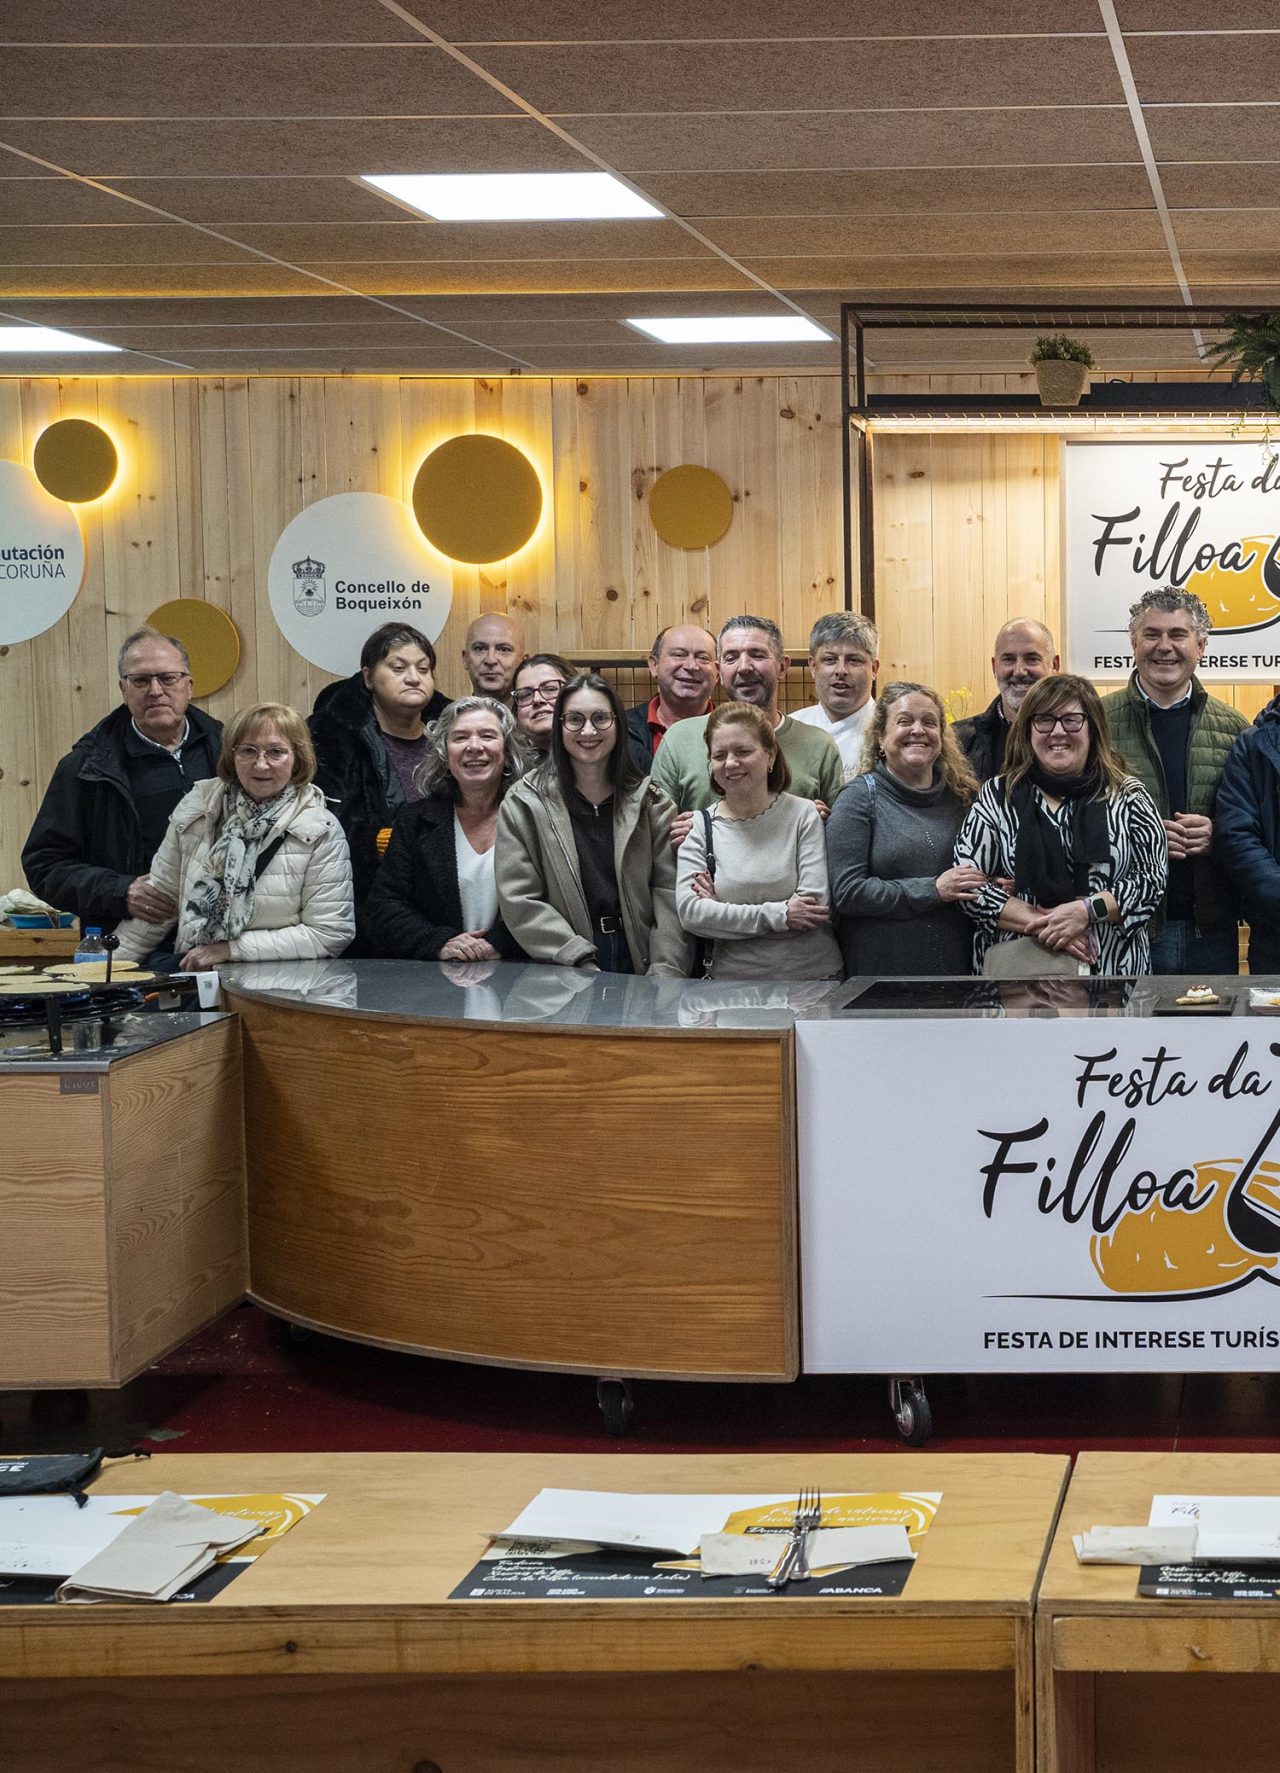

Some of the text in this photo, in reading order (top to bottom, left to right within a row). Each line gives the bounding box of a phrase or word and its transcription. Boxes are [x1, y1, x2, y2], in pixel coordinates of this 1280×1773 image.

[1159, 457, 1244, 500] Festa
[0, 544, 64, 560] utación
[1091, 501, 1255, 587] Filloa
[335, 580, 431, 594] Concello de
[336, 597, 422, 613] Boqueixón
[1200, 655, 1248, 667] ERESE
[1074, 1041, 1274, 1108] Festa da
[976, 1110, 1215, 1232] Filloa
[983, 1332, 1053, 1349] FESTA
[1059, 1332, 1090, 1349] DE
[1095, 1331, 1205, 1349] INTERESE
